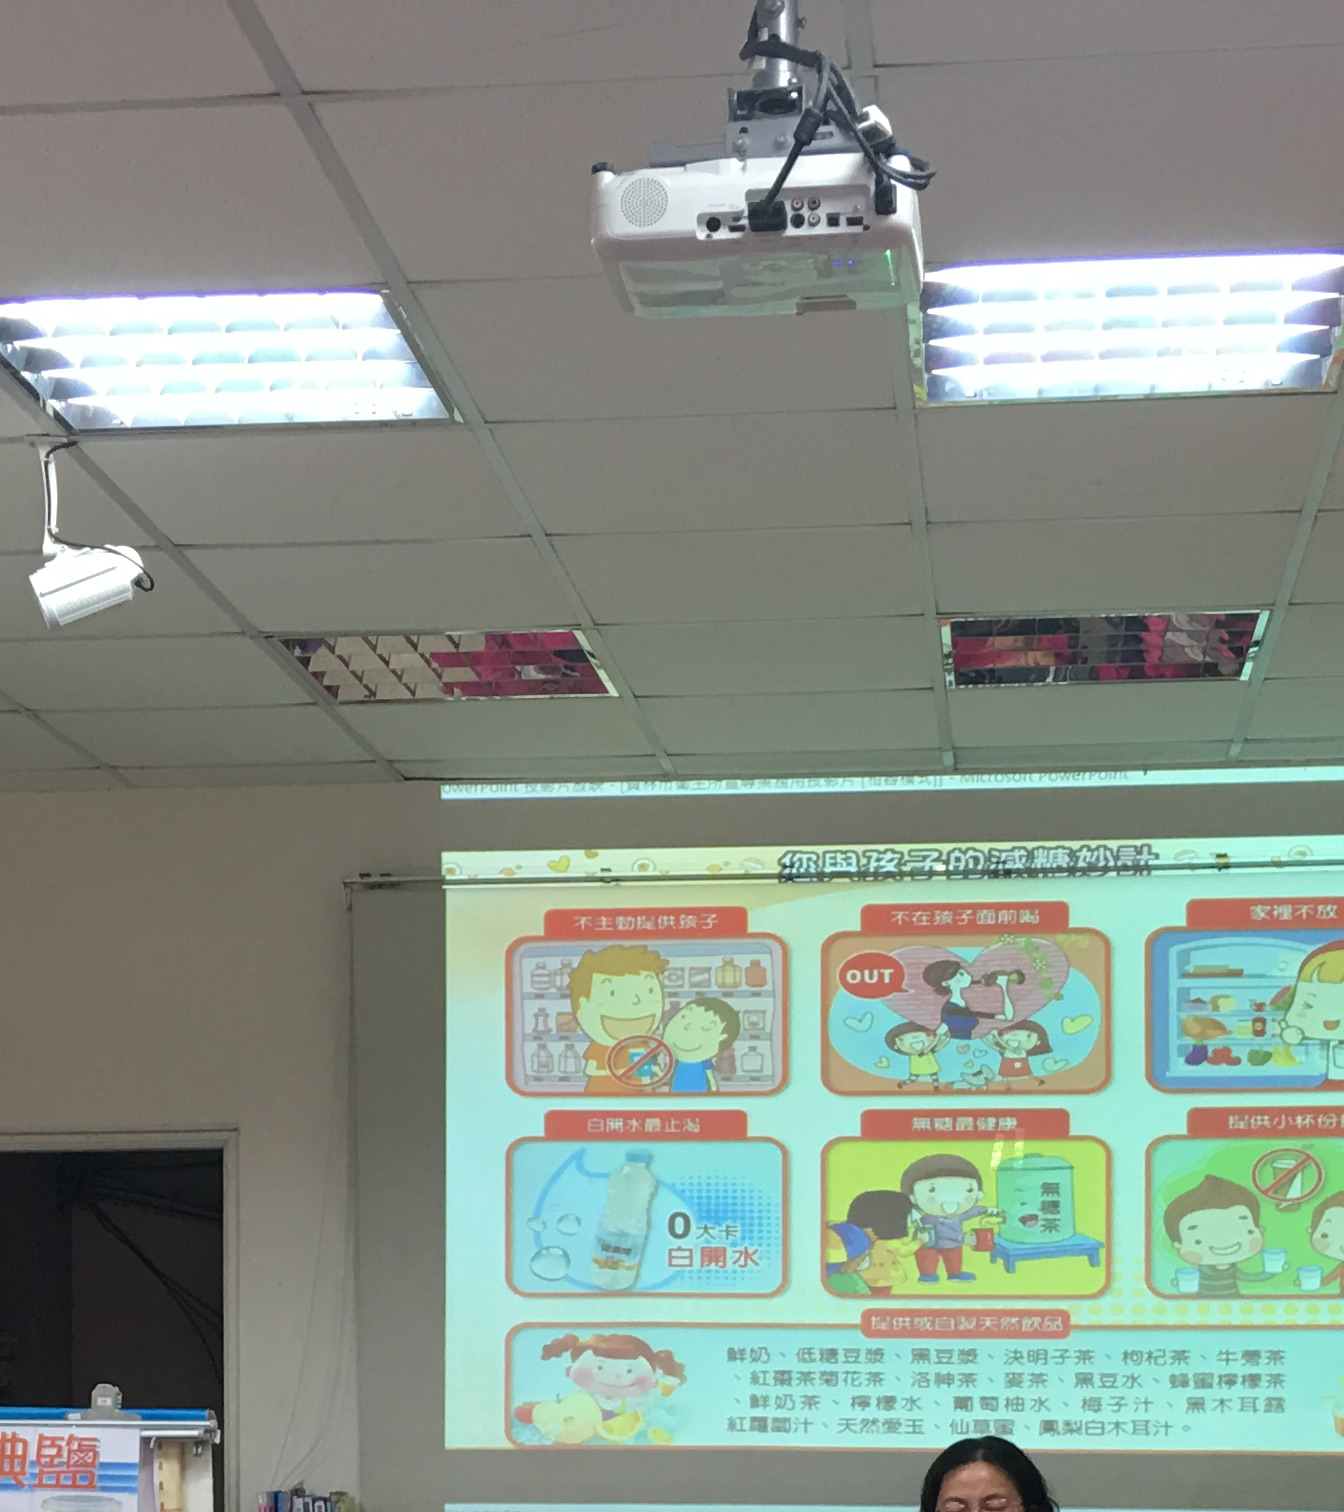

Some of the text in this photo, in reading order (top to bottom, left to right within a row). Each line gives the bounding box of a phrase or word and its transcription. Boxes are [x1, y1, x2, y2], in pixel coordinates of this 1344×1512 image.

[778, 843, 1158, 883] 您與孩子的減糖妙計
[890, 909, 1040, 926] 不在孩子面前喝
[1249, 903, 1338, 921] 家裡不放
[572, 912, 719, 931] 不主動提供孩子
[845, 968, 895, 984] OUT
[587, 1117, 701, 1132] 白開水最止渴
[912, 1116, 1019, 1132] 無糖最健康
[1040, 1181, 1062, 1234] 無糖茶
[667, 1246, 760, 1269] 白開水
[869, 1315, 1064, 1332] 提供或自製天然飲品
